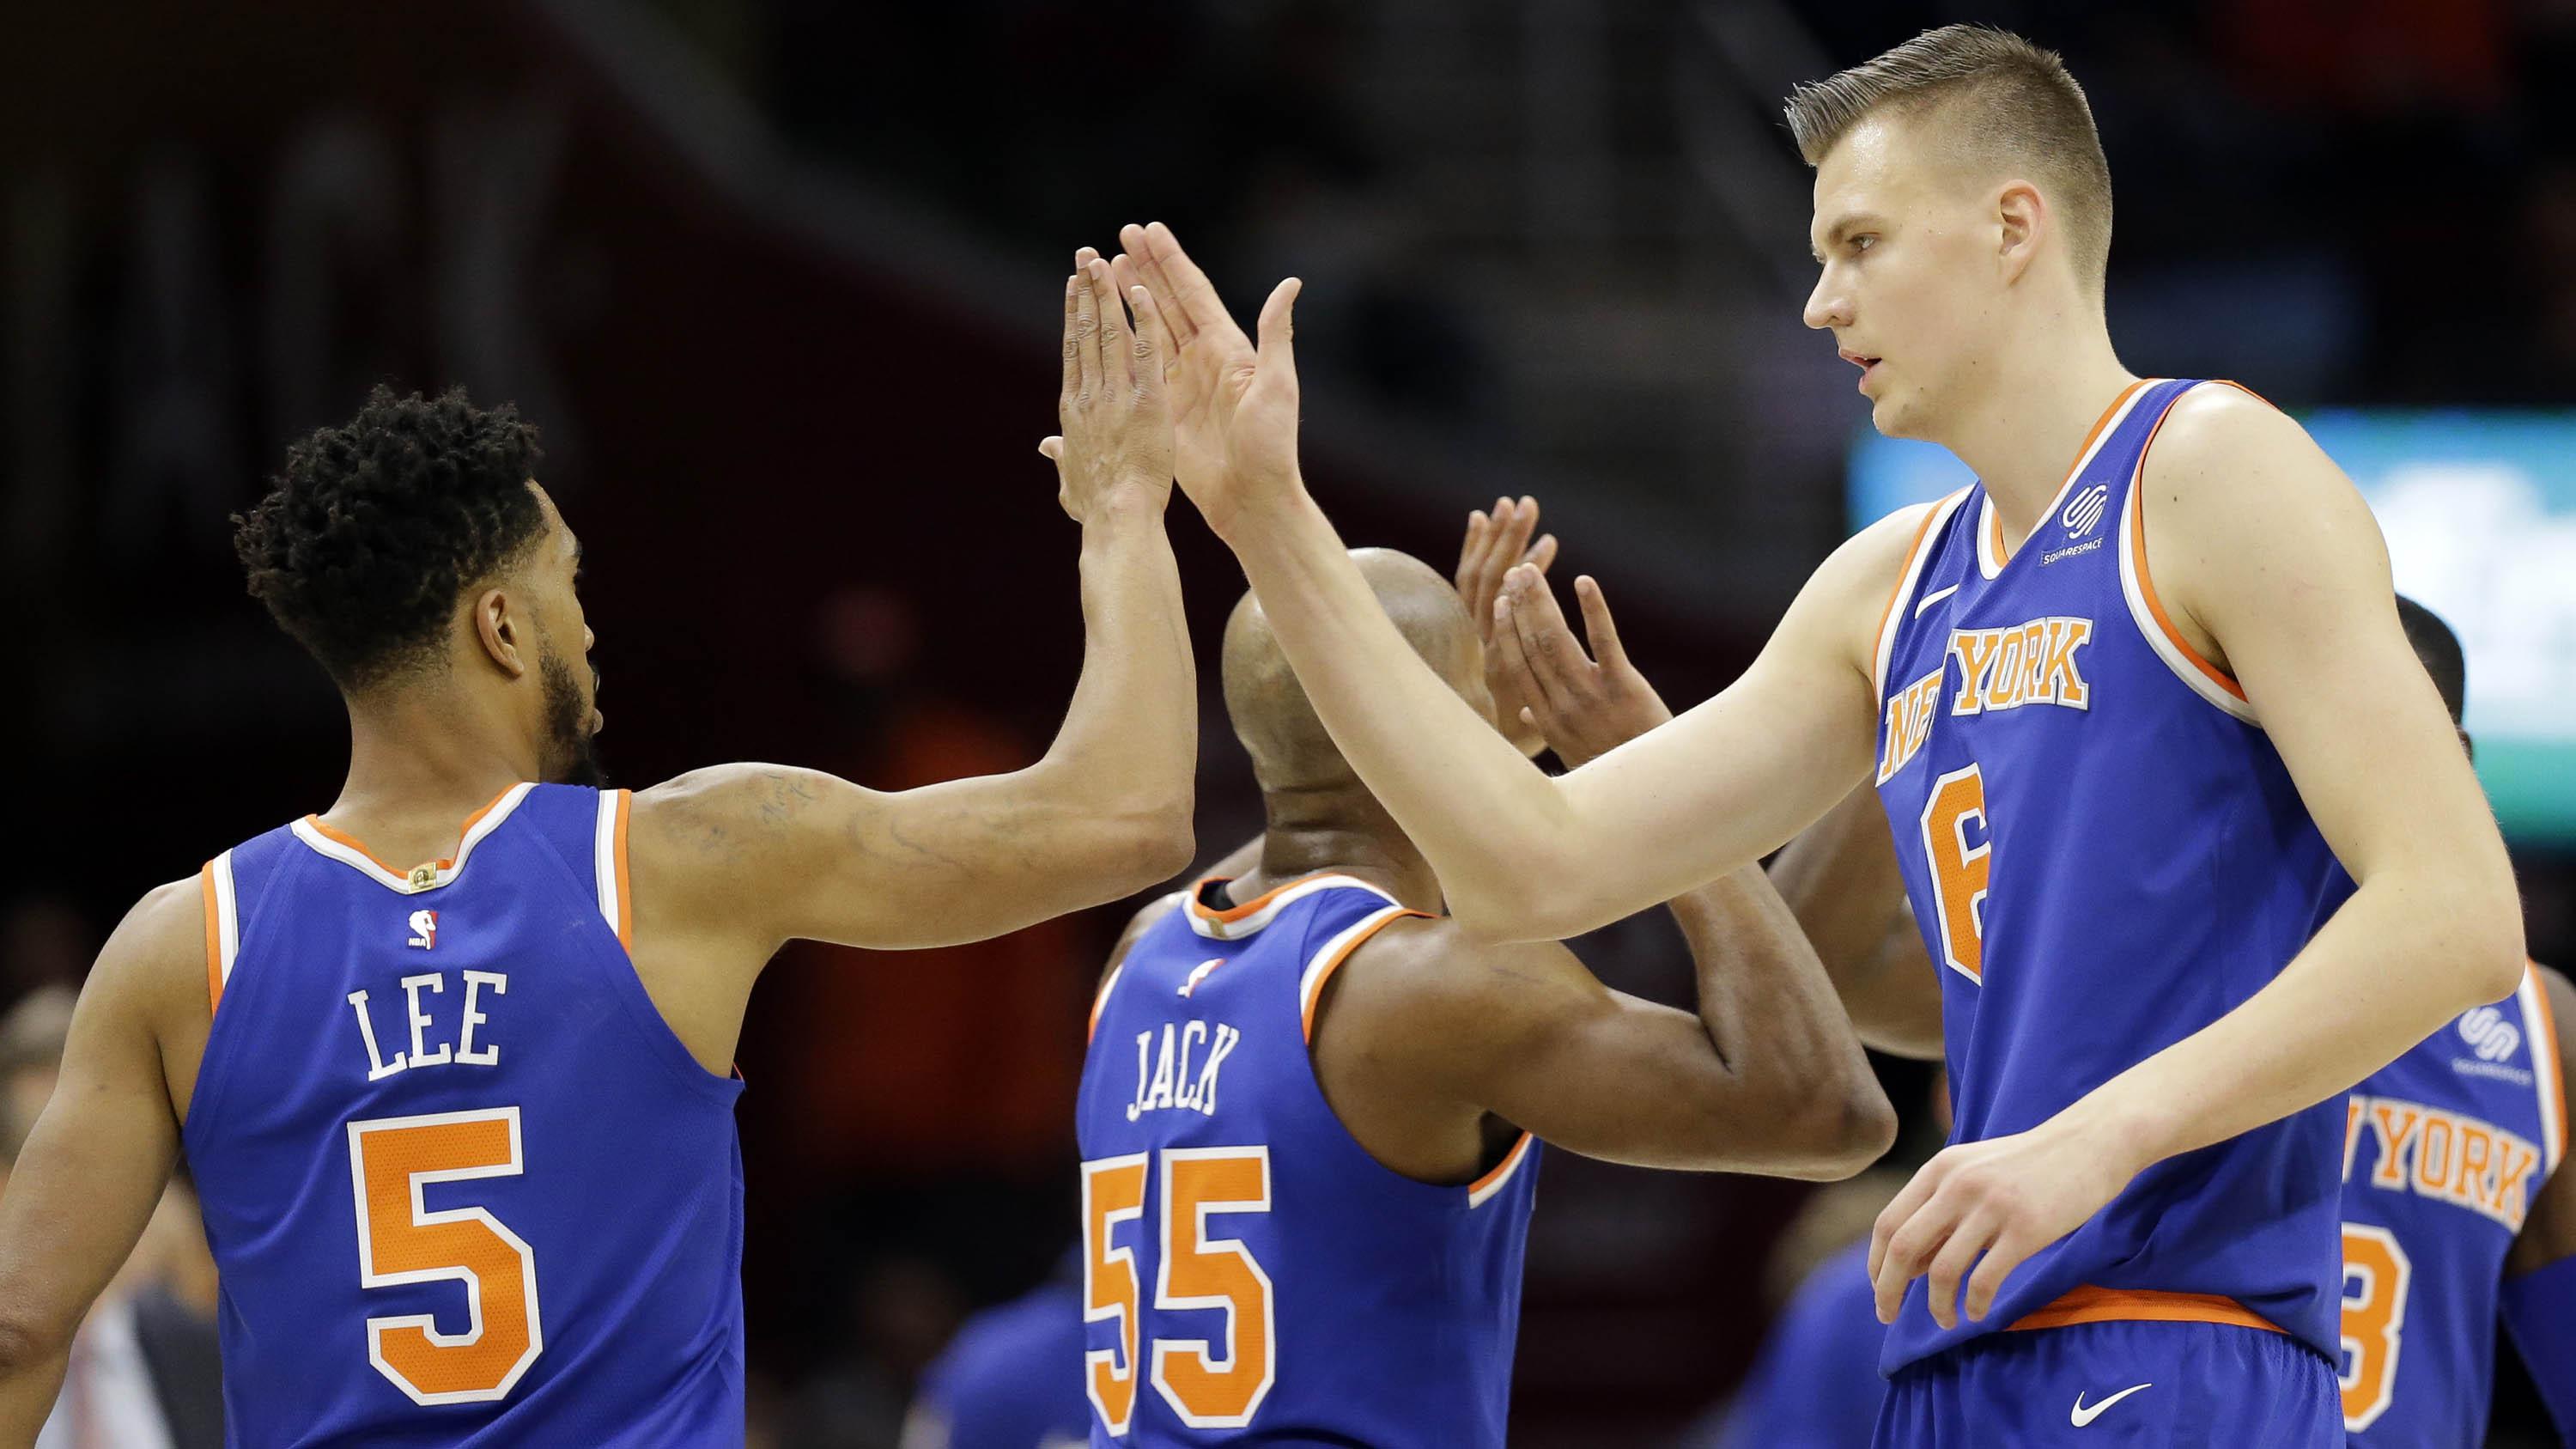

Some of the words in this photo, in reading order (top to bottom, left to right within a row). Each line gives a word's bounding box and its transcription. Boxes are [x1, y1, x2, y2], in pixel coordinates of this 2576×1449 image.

[2043, 537, 2103, 564] SQUARESPACE
[1875, 666, 1947, 788] NE
[1947, 615, 2093, 716] YORK
[408, 936, 427, 947] NBA
[347, 969, 507, 1081] LEE
[1127, 1020, 1240, 1122] JACK
[2366, 1095, 2541, 1237] YORK
[347, 1105, 544, 1407] 5
[1080, 1145, 1275, 1438] 55
